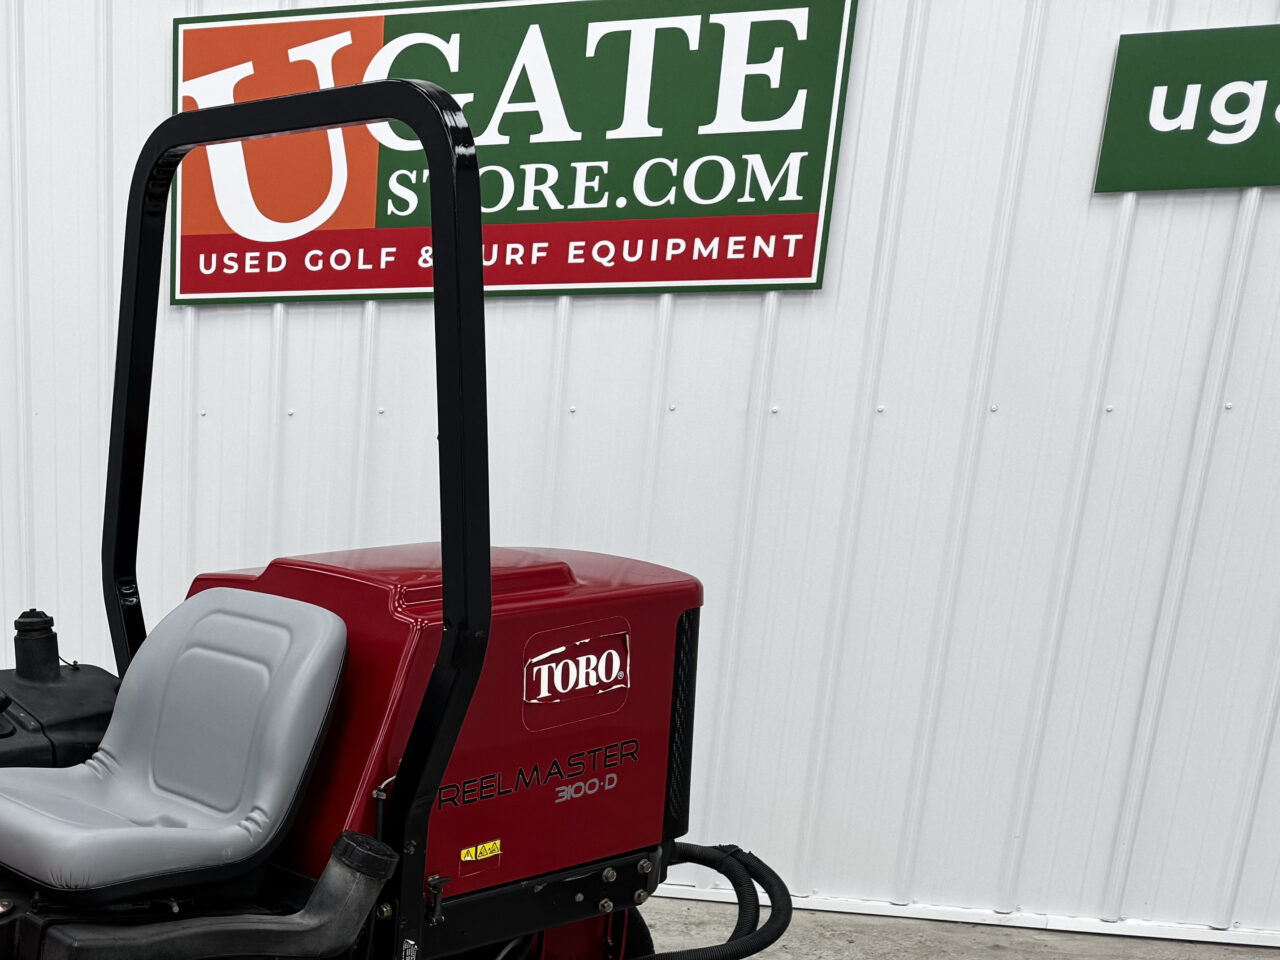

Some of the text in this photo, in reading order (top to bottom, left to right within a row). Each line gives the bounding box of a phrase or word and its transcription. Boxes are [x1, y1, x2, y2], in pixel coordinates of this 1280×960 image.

[1149, 80, 1280, 145] ug
[387, 151, 809, 216] SORE.COM
[198, 234, 804, 276] USED GOLF & URF EQUIPMENT
[532, 649, 621, 699] TORO
[437, 738, 640, 811] REELMASTER
